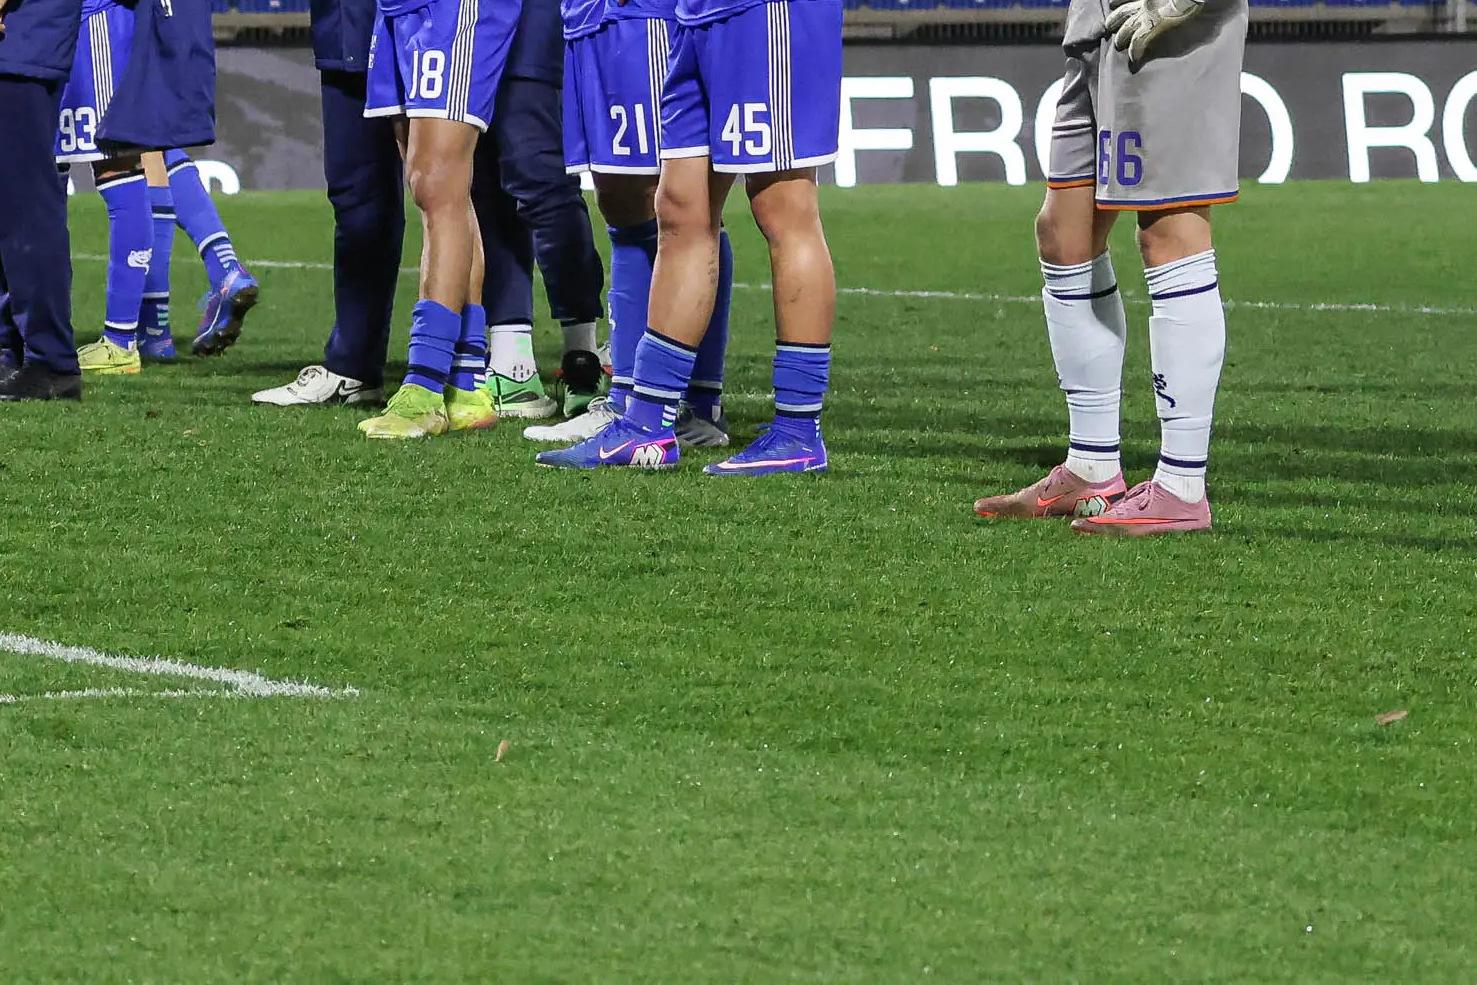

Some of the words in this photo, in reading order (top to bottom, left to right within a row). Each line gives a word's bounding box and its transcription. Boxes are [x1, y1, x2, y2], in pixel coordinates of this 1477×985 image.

[59, 106, 97, 152] 93
[610, 103, 649, 157] 21
[721, 102, 772, 157] 45
